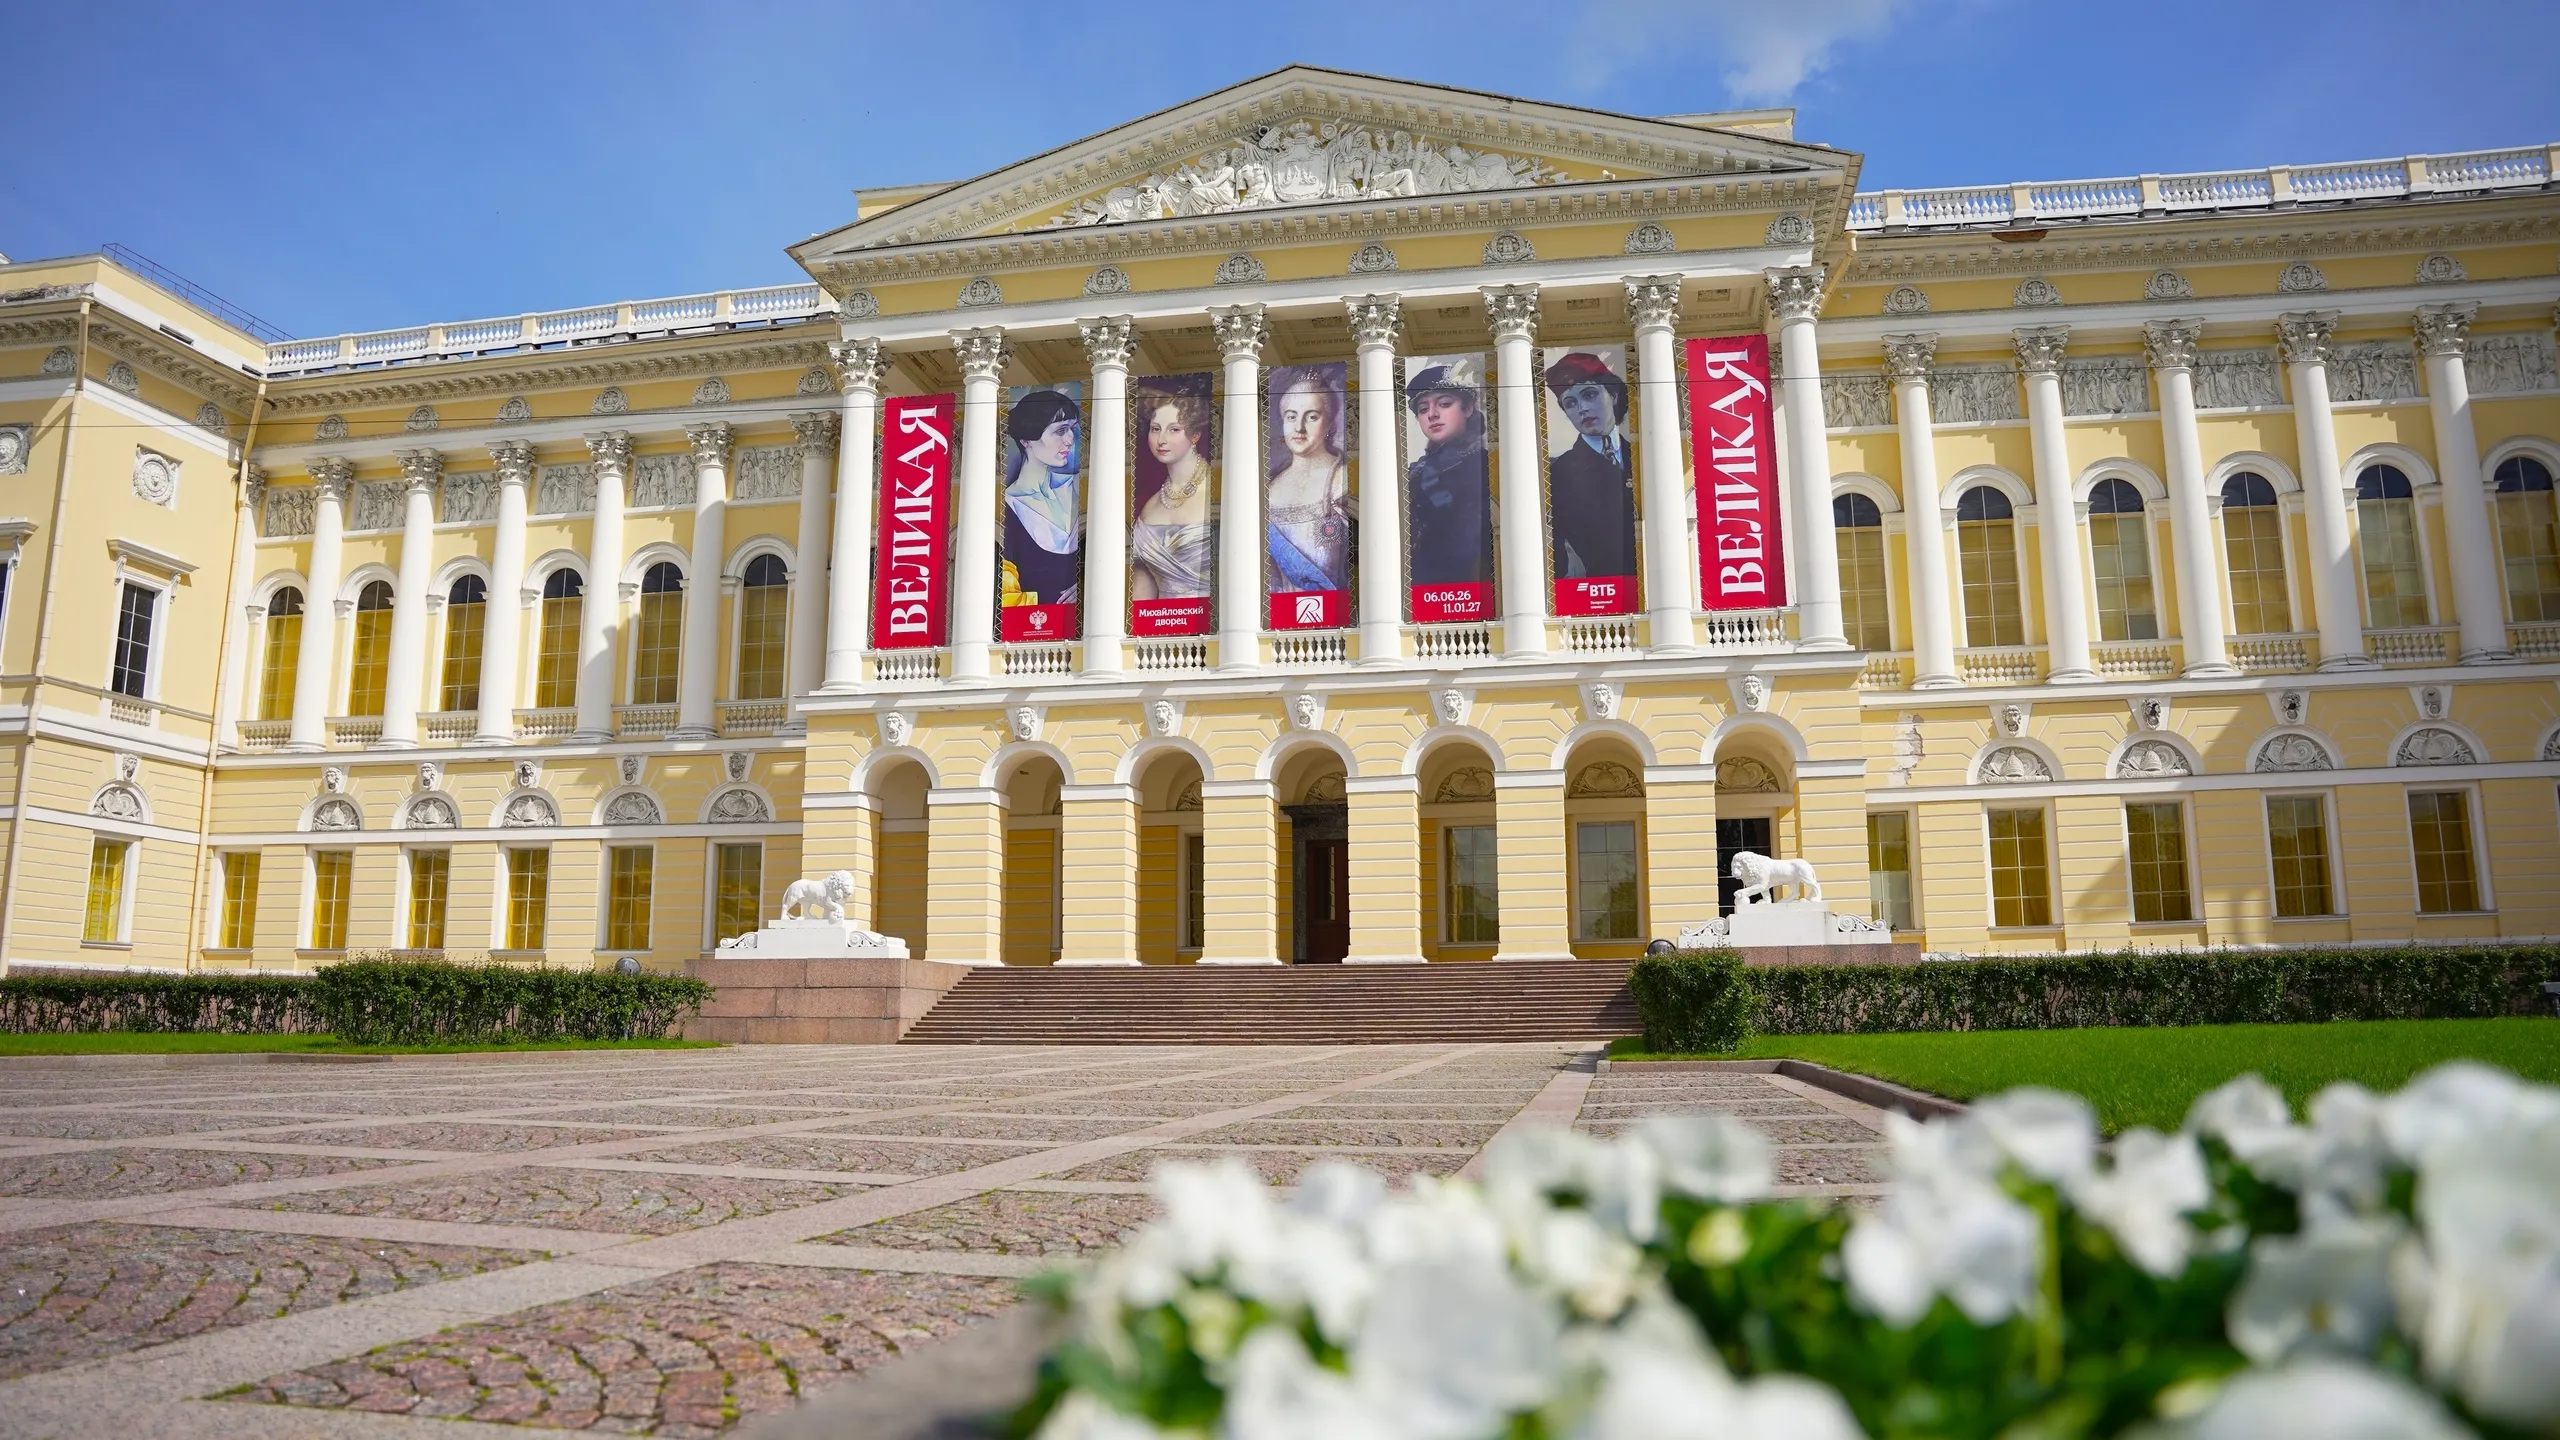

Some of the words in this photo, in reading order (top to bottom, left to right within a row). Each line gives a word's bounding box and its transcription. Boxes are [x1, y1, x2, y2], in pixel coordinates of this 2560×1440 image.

[1705, 349, 1767, 596] ВЕЛИКАЯ
[890, 405, 948, 636] ВЕЛИКАЯ
[1423, 590, 1471, 602] 06.06.26
[1589, 584, 1616, 597] ВТБ
[1139, 606, 1204, 617] Михайловский
[1443, 602, 1481, 613] 11.01.27
[1155, 618, 1187, 627] дворец
